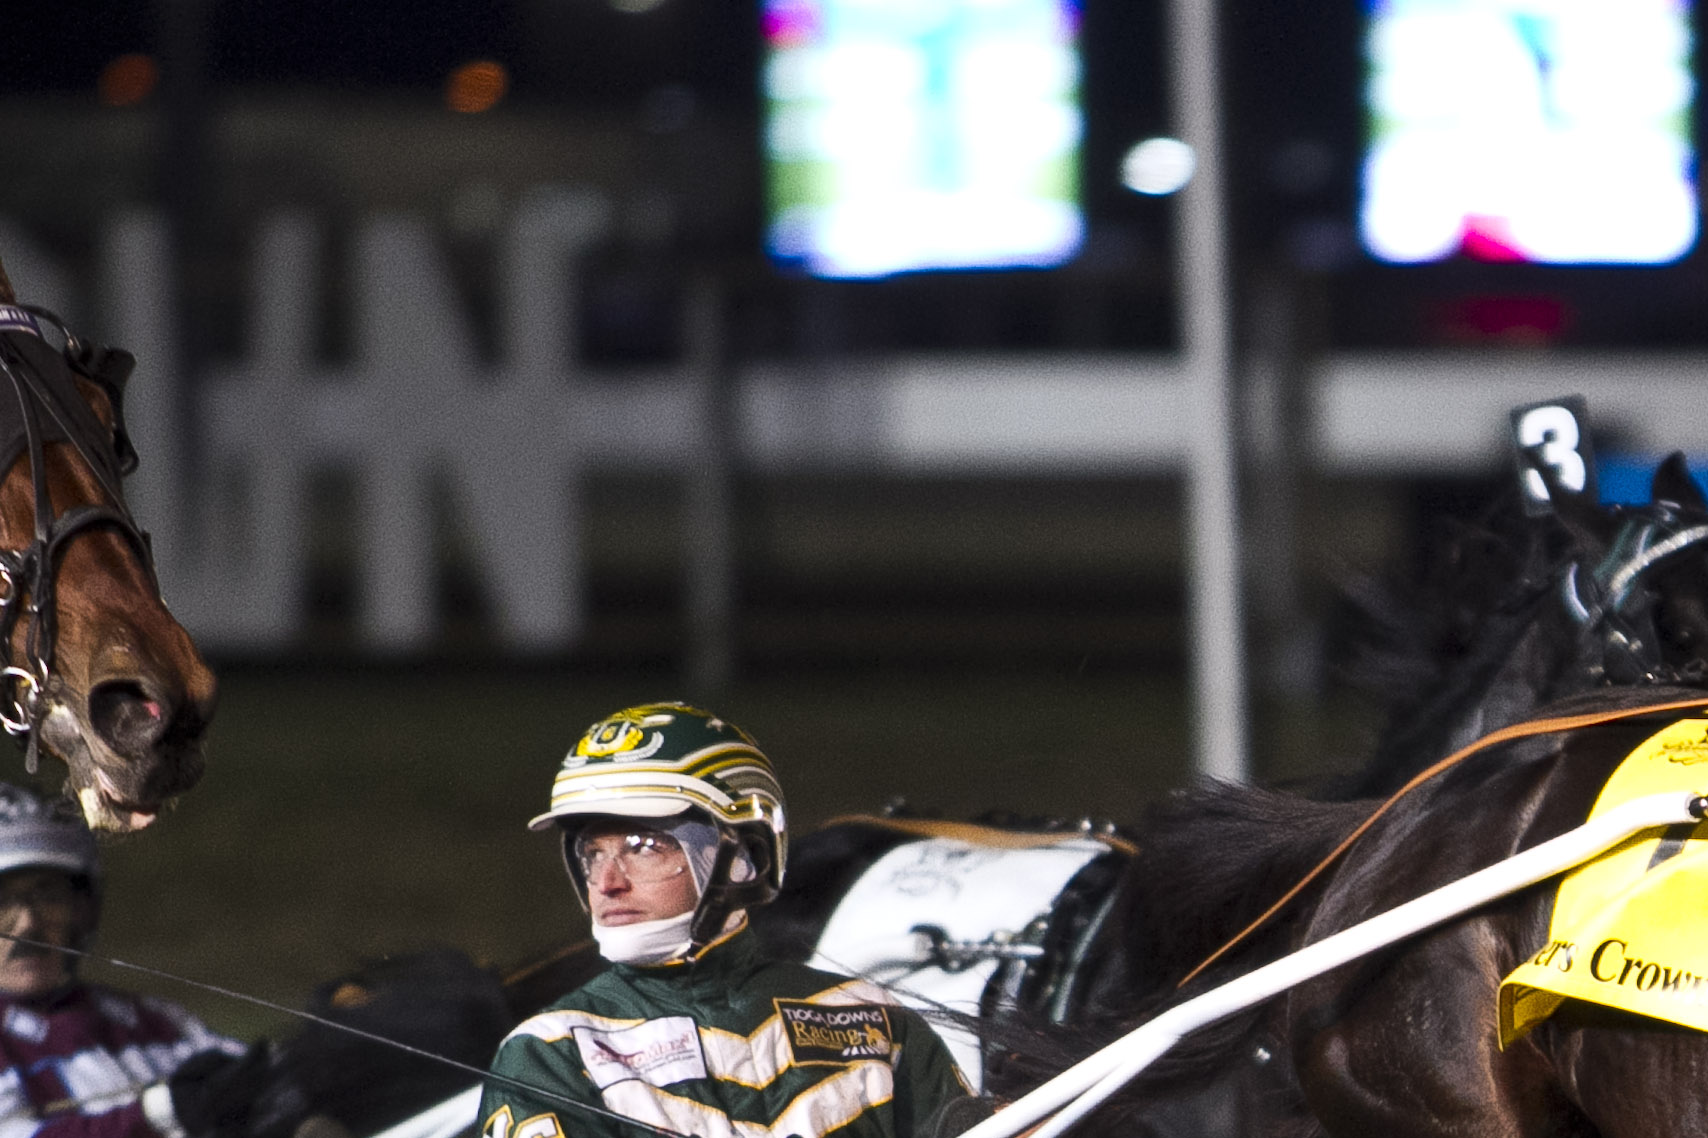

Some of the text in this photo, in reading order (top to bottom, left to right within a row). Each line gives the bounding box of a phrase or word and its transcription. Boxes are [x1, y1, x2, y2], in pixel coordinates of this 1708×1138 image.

[1520, 405, 1586, 501] 3
[826, 1010, 883, 1026] DOWNS
[791, 1020, 861, 1046] Racing
